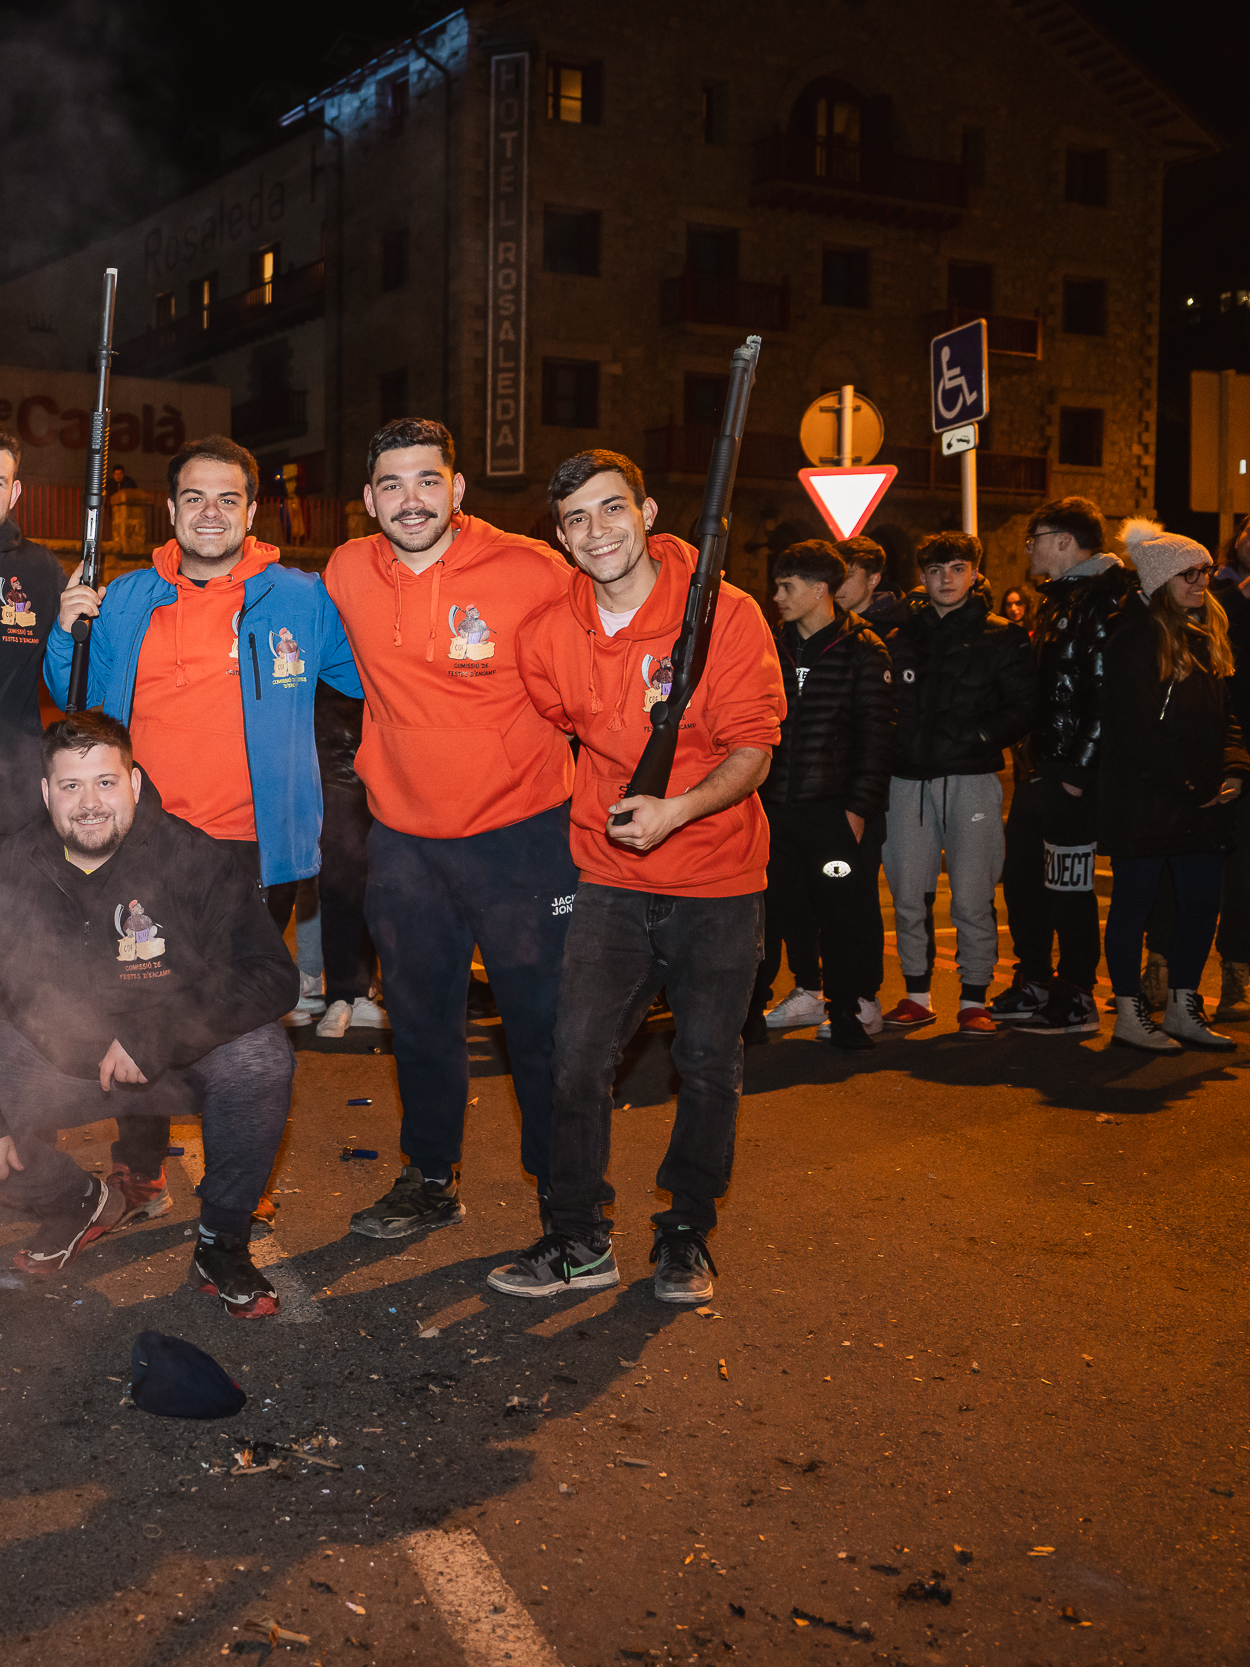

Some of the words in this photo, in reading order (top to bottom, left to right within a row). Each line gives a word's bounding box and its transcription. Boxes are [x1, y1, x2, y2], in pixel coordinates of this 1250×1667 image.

[500, 62, 519, 227] HOTEL
[144, 171, 286, 281] Rosaleda
[496, 241, 517, 447] ROSALEDA
[17, 394, 186, 456] Caalà
[552, 903, 573, 916] JON
